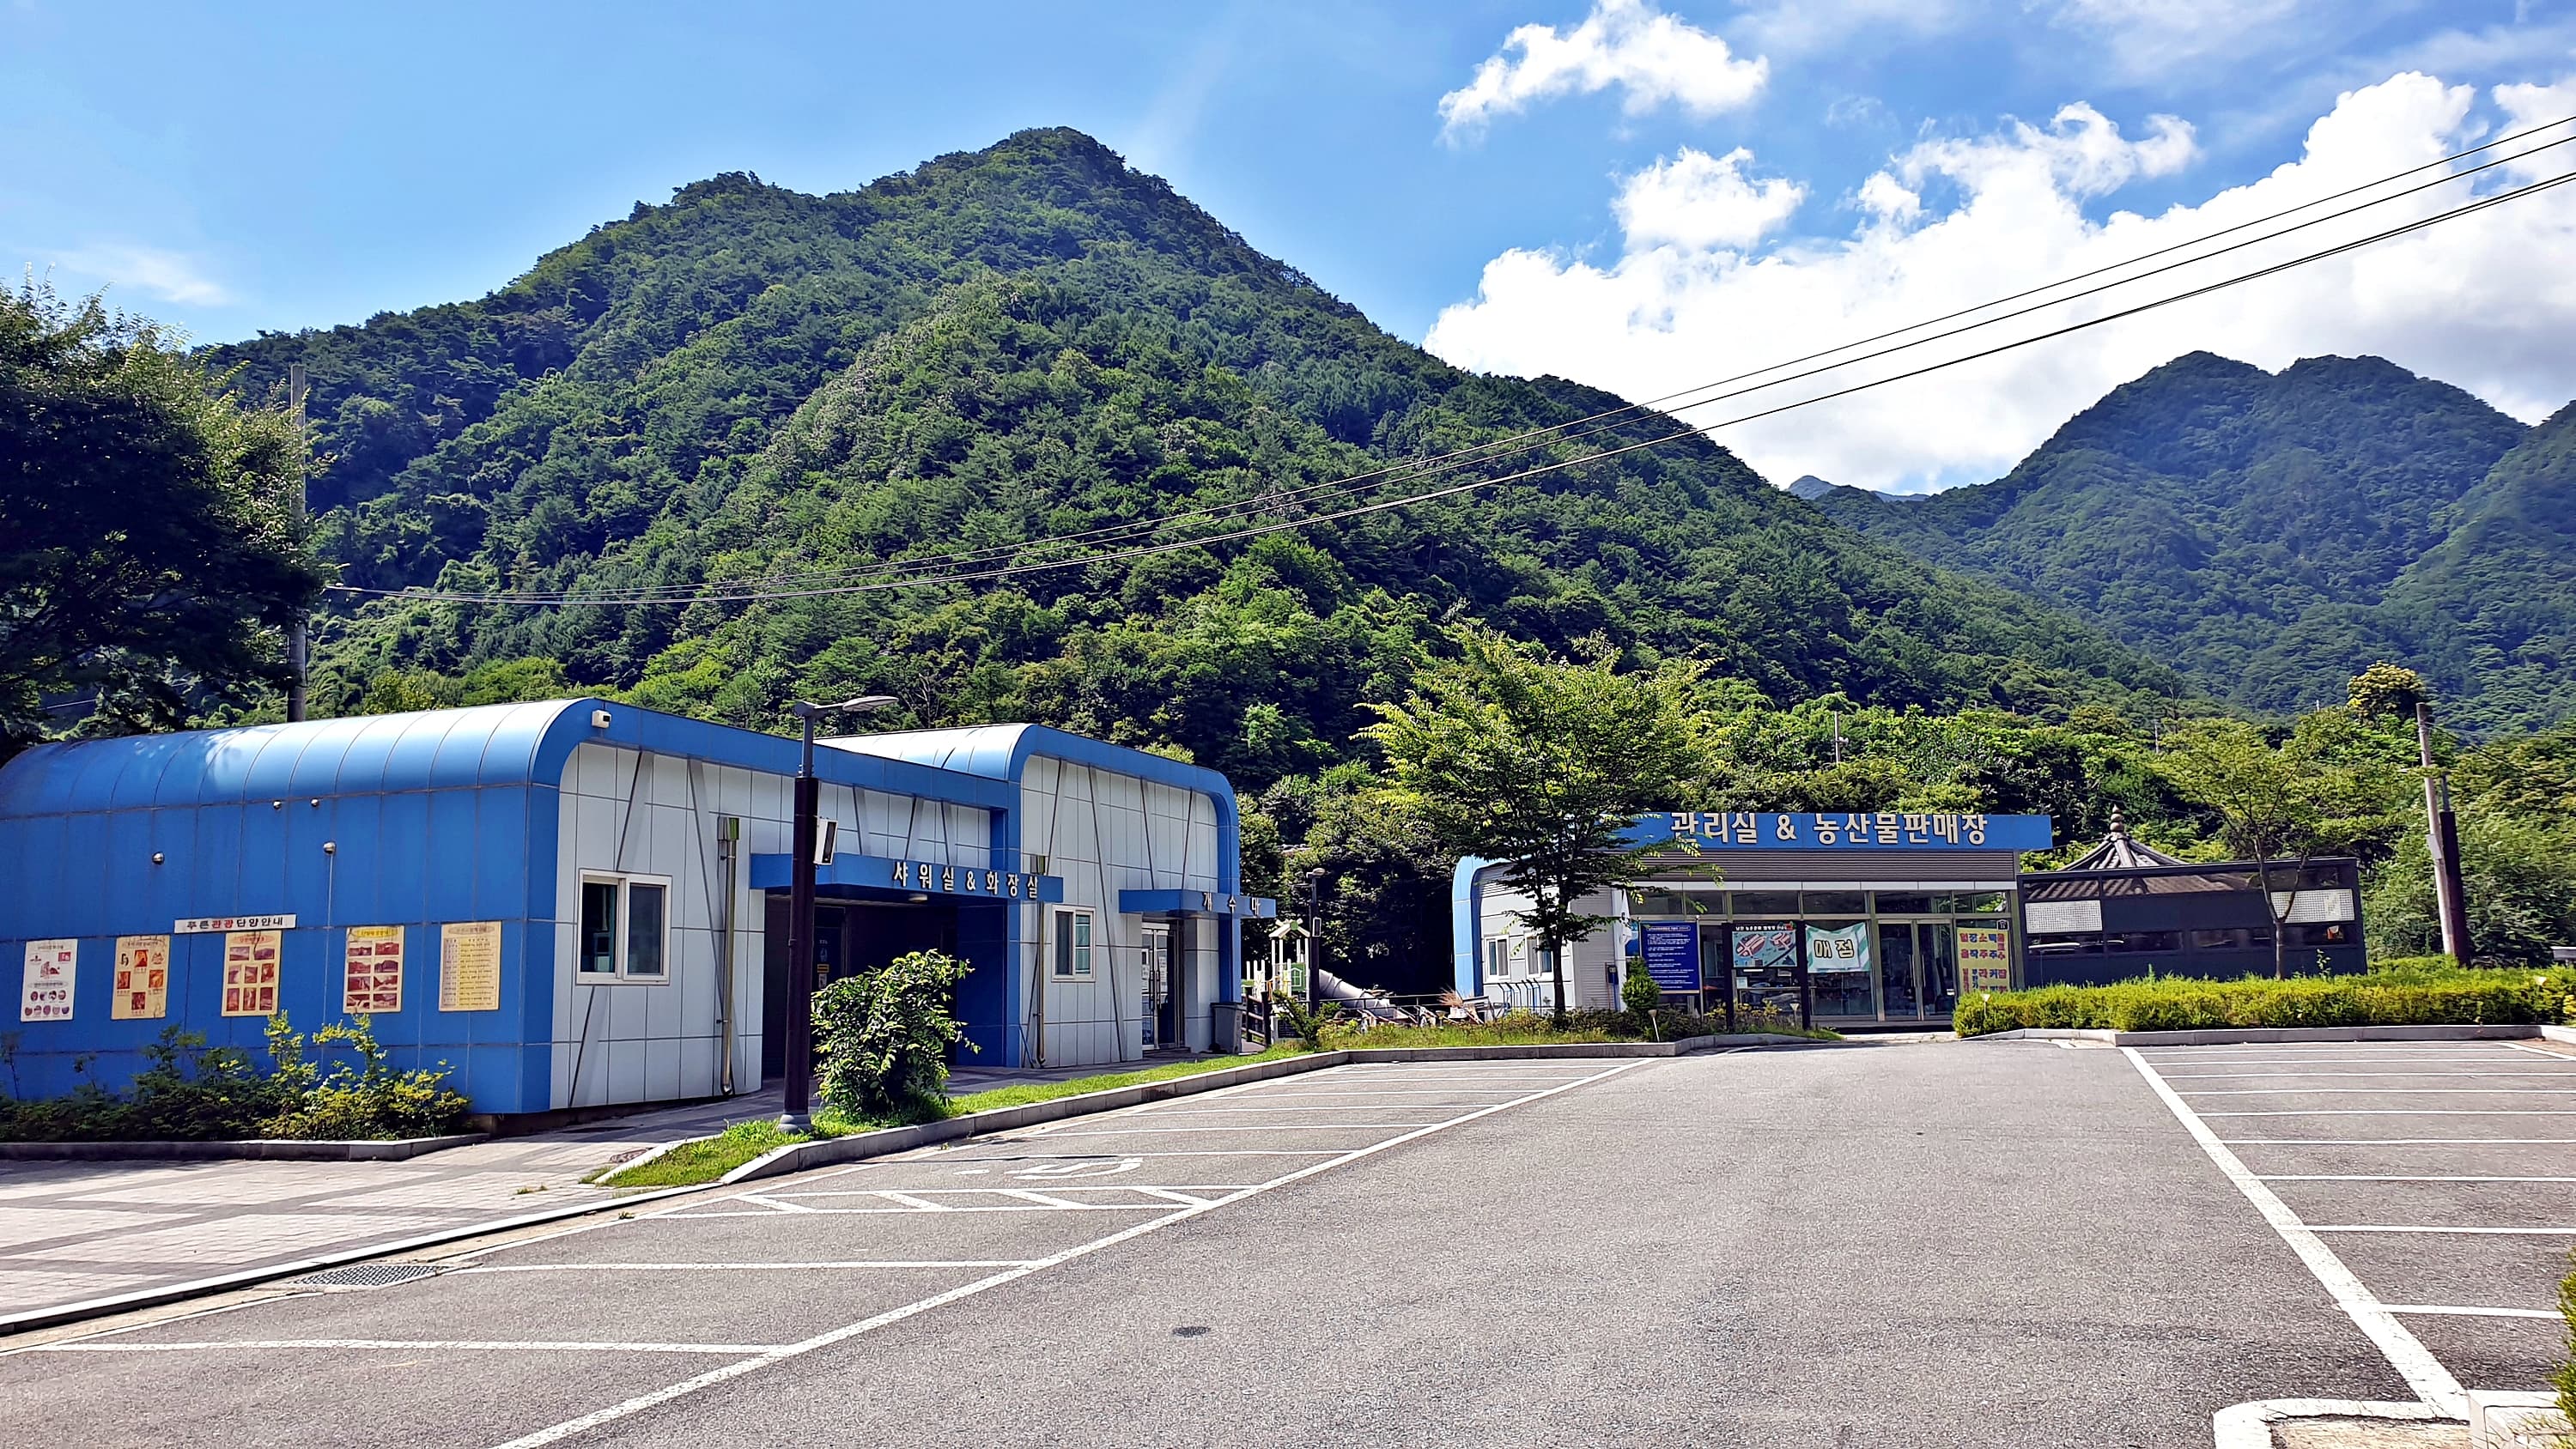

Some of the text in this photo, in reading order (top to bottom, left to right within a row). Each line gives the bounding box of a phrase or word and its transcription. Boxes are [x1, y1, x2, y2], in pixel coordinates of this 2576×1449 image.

[1670, 812, 1988, 846] 관리실 & 농산물판매장
[1814, 938, 1855, 960] 매점
